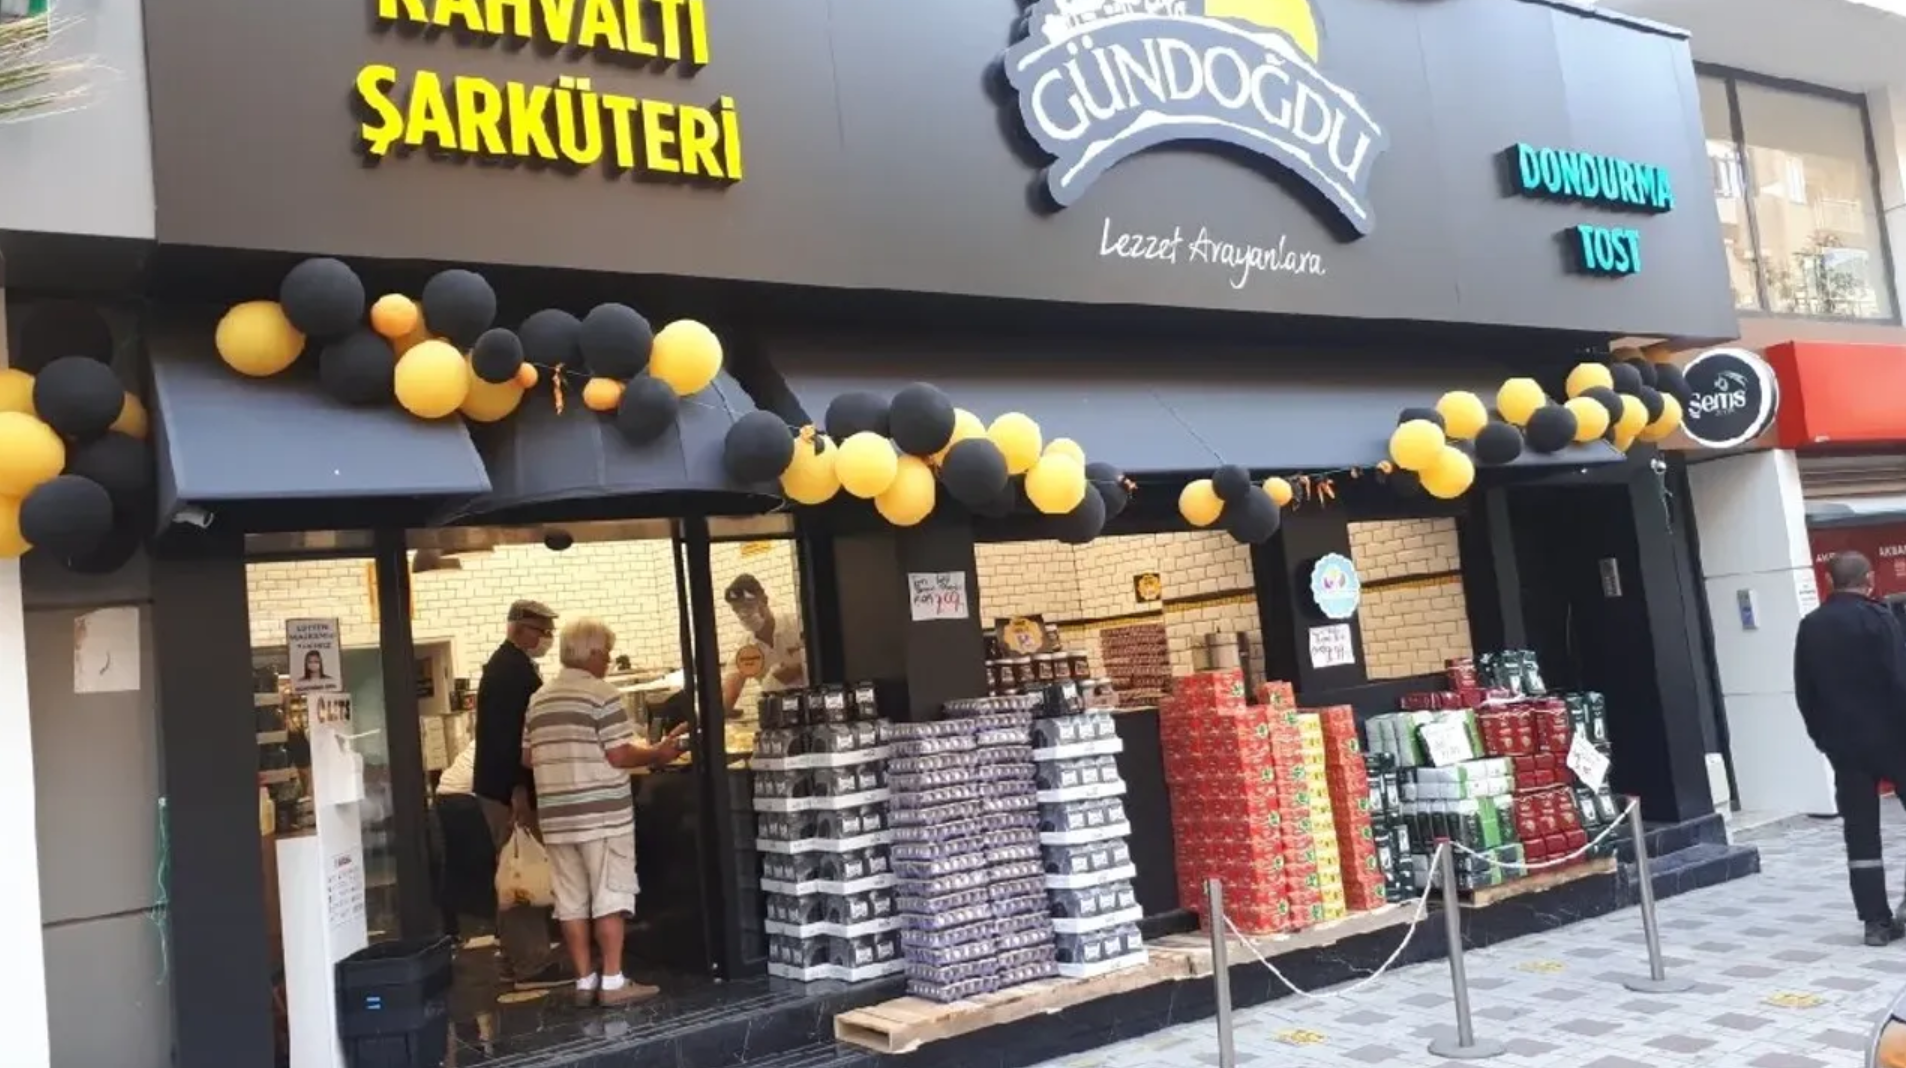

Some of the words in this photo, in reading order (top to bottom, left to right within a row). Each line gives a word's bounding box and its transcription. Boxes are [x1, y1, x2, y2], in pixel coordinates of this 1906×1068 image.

[378, 0, 710, 65] VALTI
[355, 64, 743, 182] ŞARKÜTERİ
[1031, 35, 1371, 183] GÜNDOĞDU
[1517, 141, 1675, 209] DONDURMA
[1099, 216, 1181, 265] Lezzet
[1188, 227, 1327, 290] Arayanlara
[1577, 223, 1642, 274] TOST
